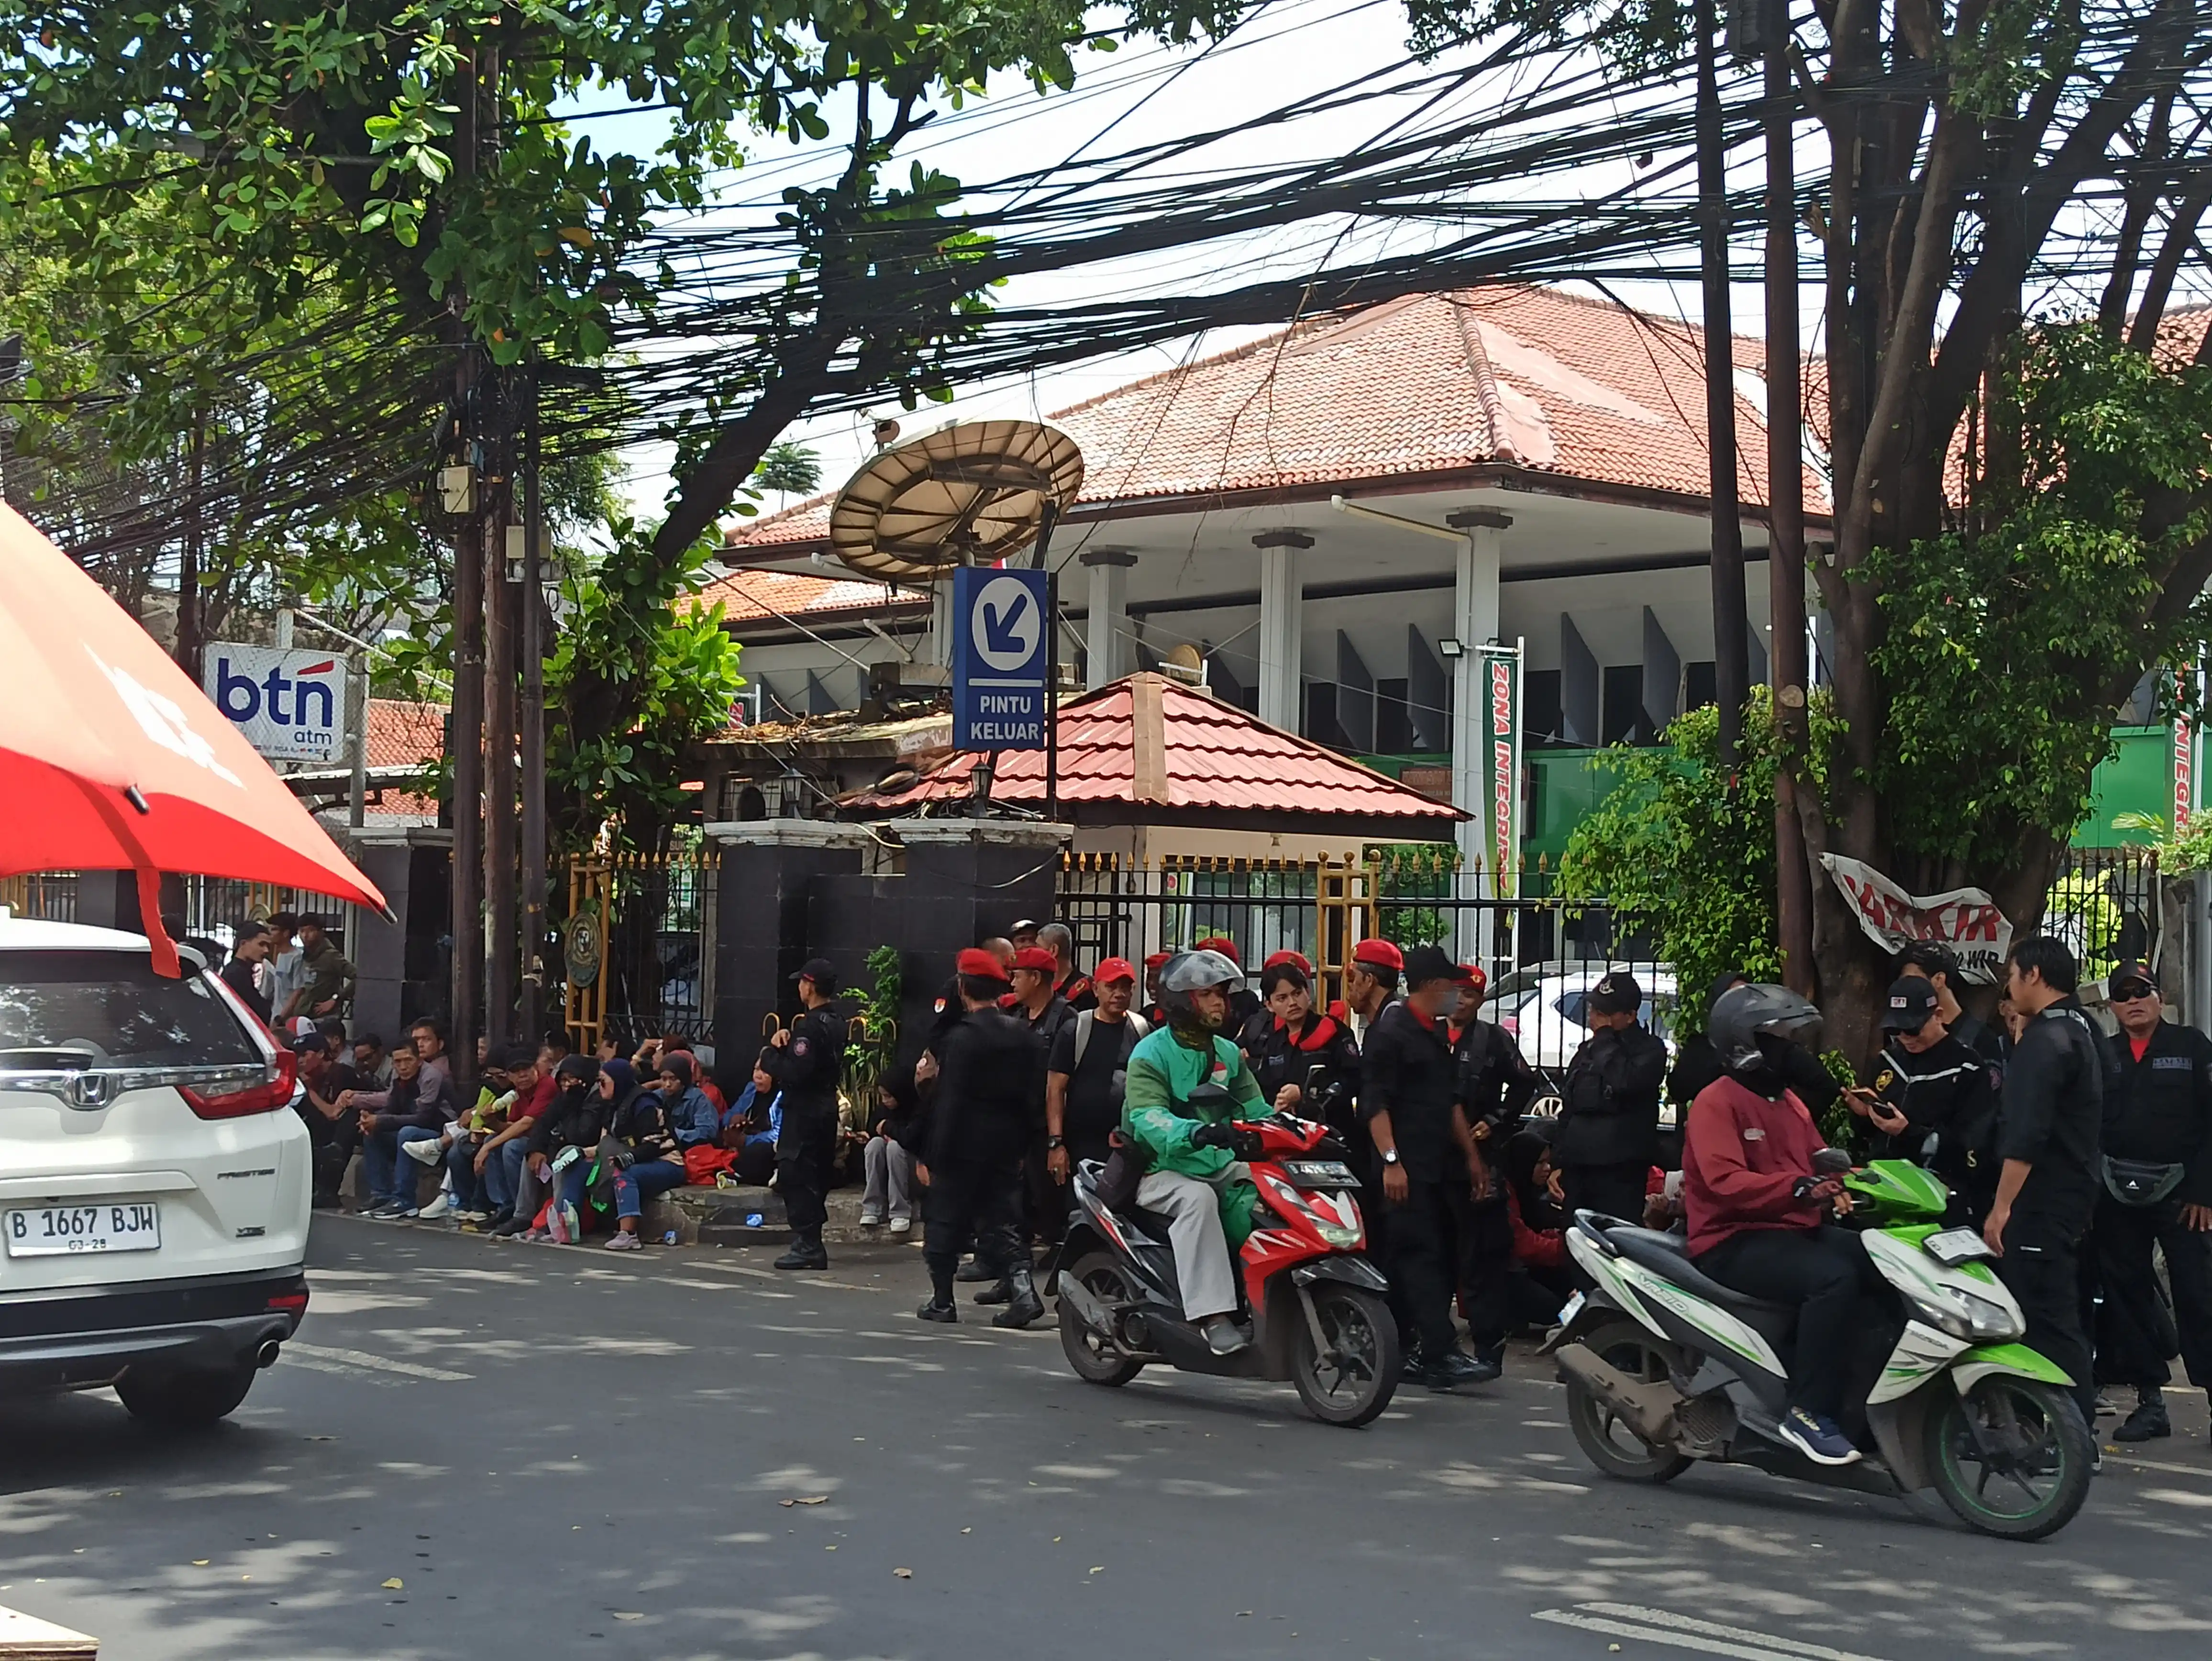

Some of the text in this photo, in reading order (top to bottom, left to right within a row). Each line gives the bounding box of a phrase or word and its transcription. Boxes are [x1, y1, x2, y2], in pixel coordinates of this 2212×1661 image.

[217, 657, 334, 727] btn
[1492, 660, 1510, 736] ZONA
[980, 696, 1031, 714] PINTU
[294, 730, 332, 745] atm
[971, 722, 1039, 740] KELUAR
[12, 1206, 154, 1238] B 1667 BJW
